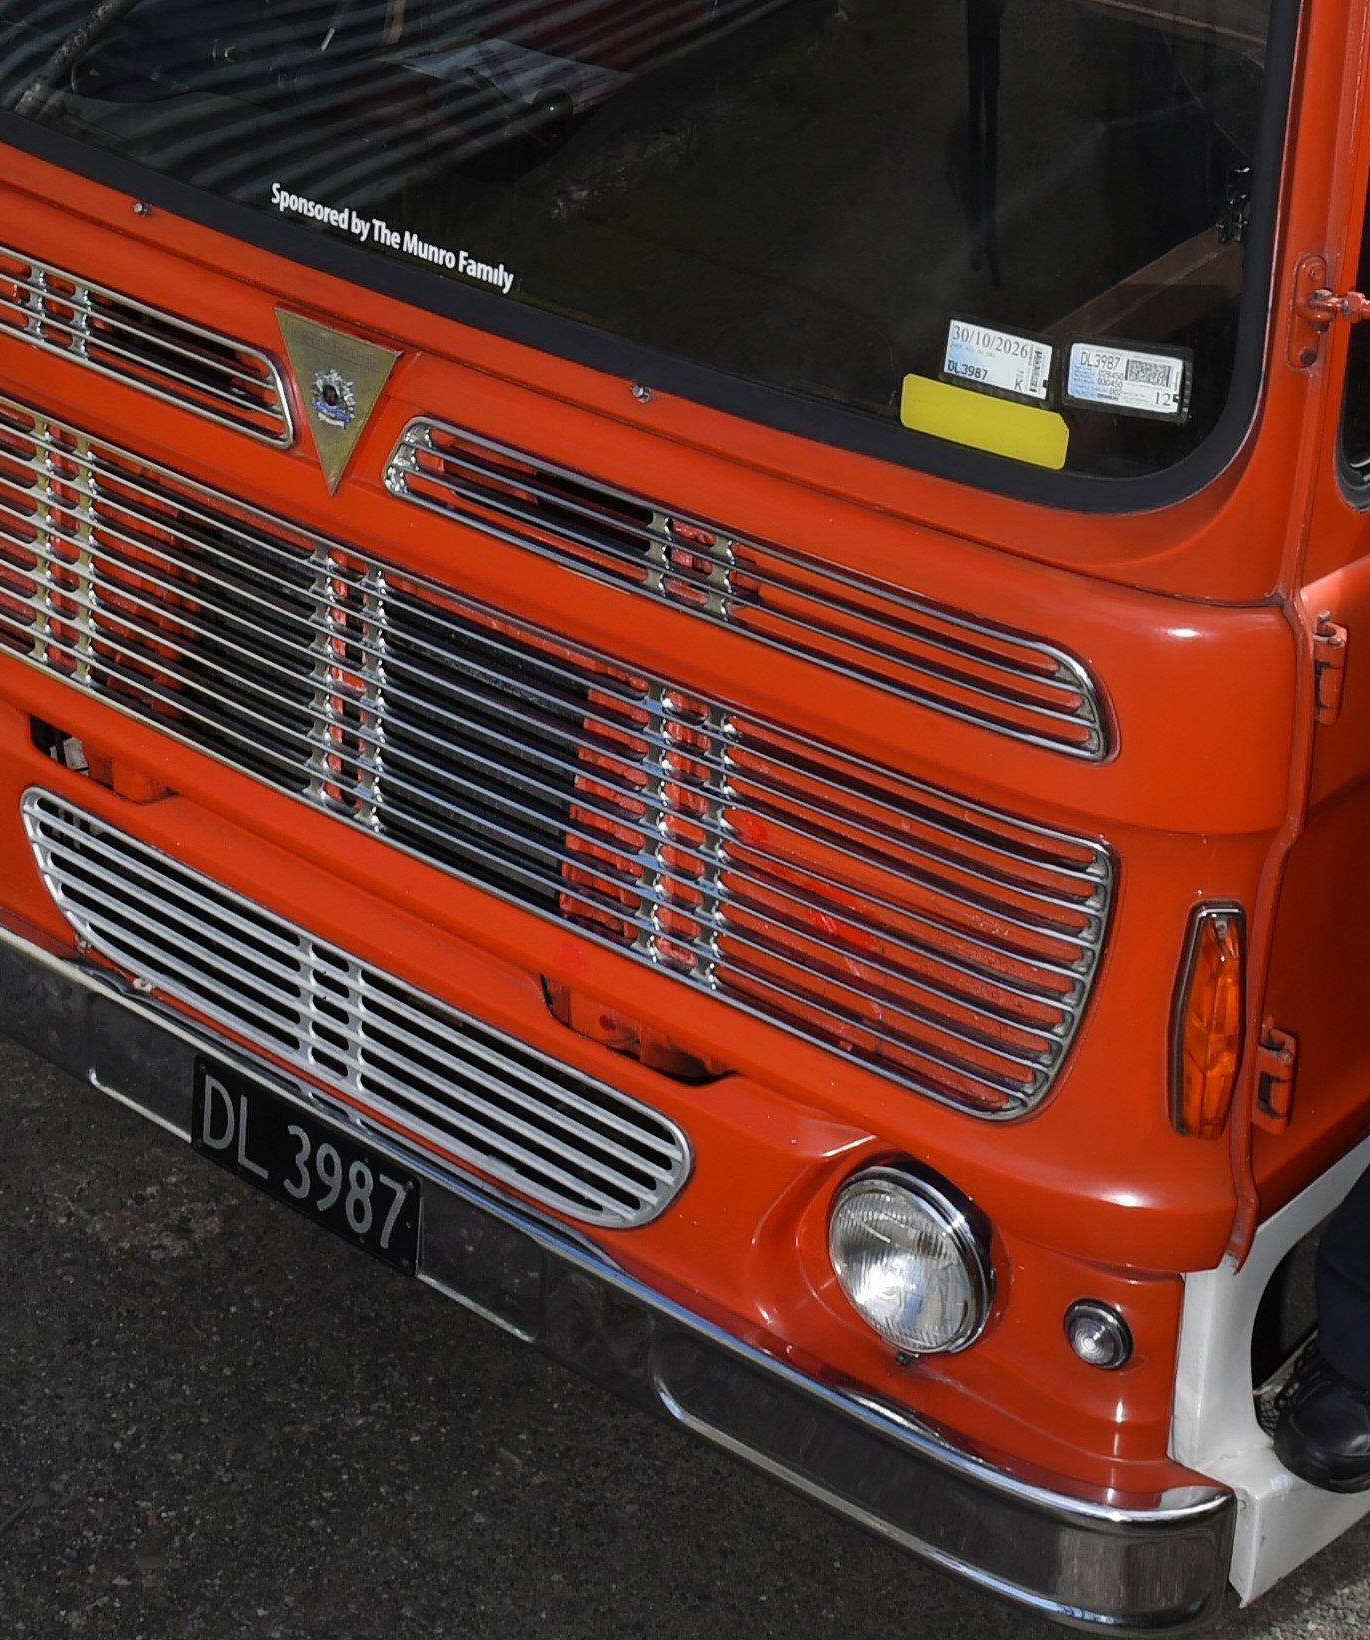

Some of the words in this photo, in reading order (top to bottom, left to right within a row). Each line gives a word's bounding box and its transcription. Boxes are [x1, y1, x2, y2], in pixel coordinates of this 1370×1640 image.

[271, 182, 349, 232] Sponsored
[350, 210, 371, 242] by
[372, 218, 401, 250] The
[402, 230, 456, 269] Munro
[458, 250, 514, 294] Family
[952, 325, 1028, 359] 30/10/2026
[947, 359, 988, 381] DL3987
[1080, 351, 1120, 371] DL3987
[1014, 377, 1024, 391] K
[1154, 391, 1171, 407] 12
[202, 1074, 270, 1180] DL
[283, 1124, 407, 1250] 3987
